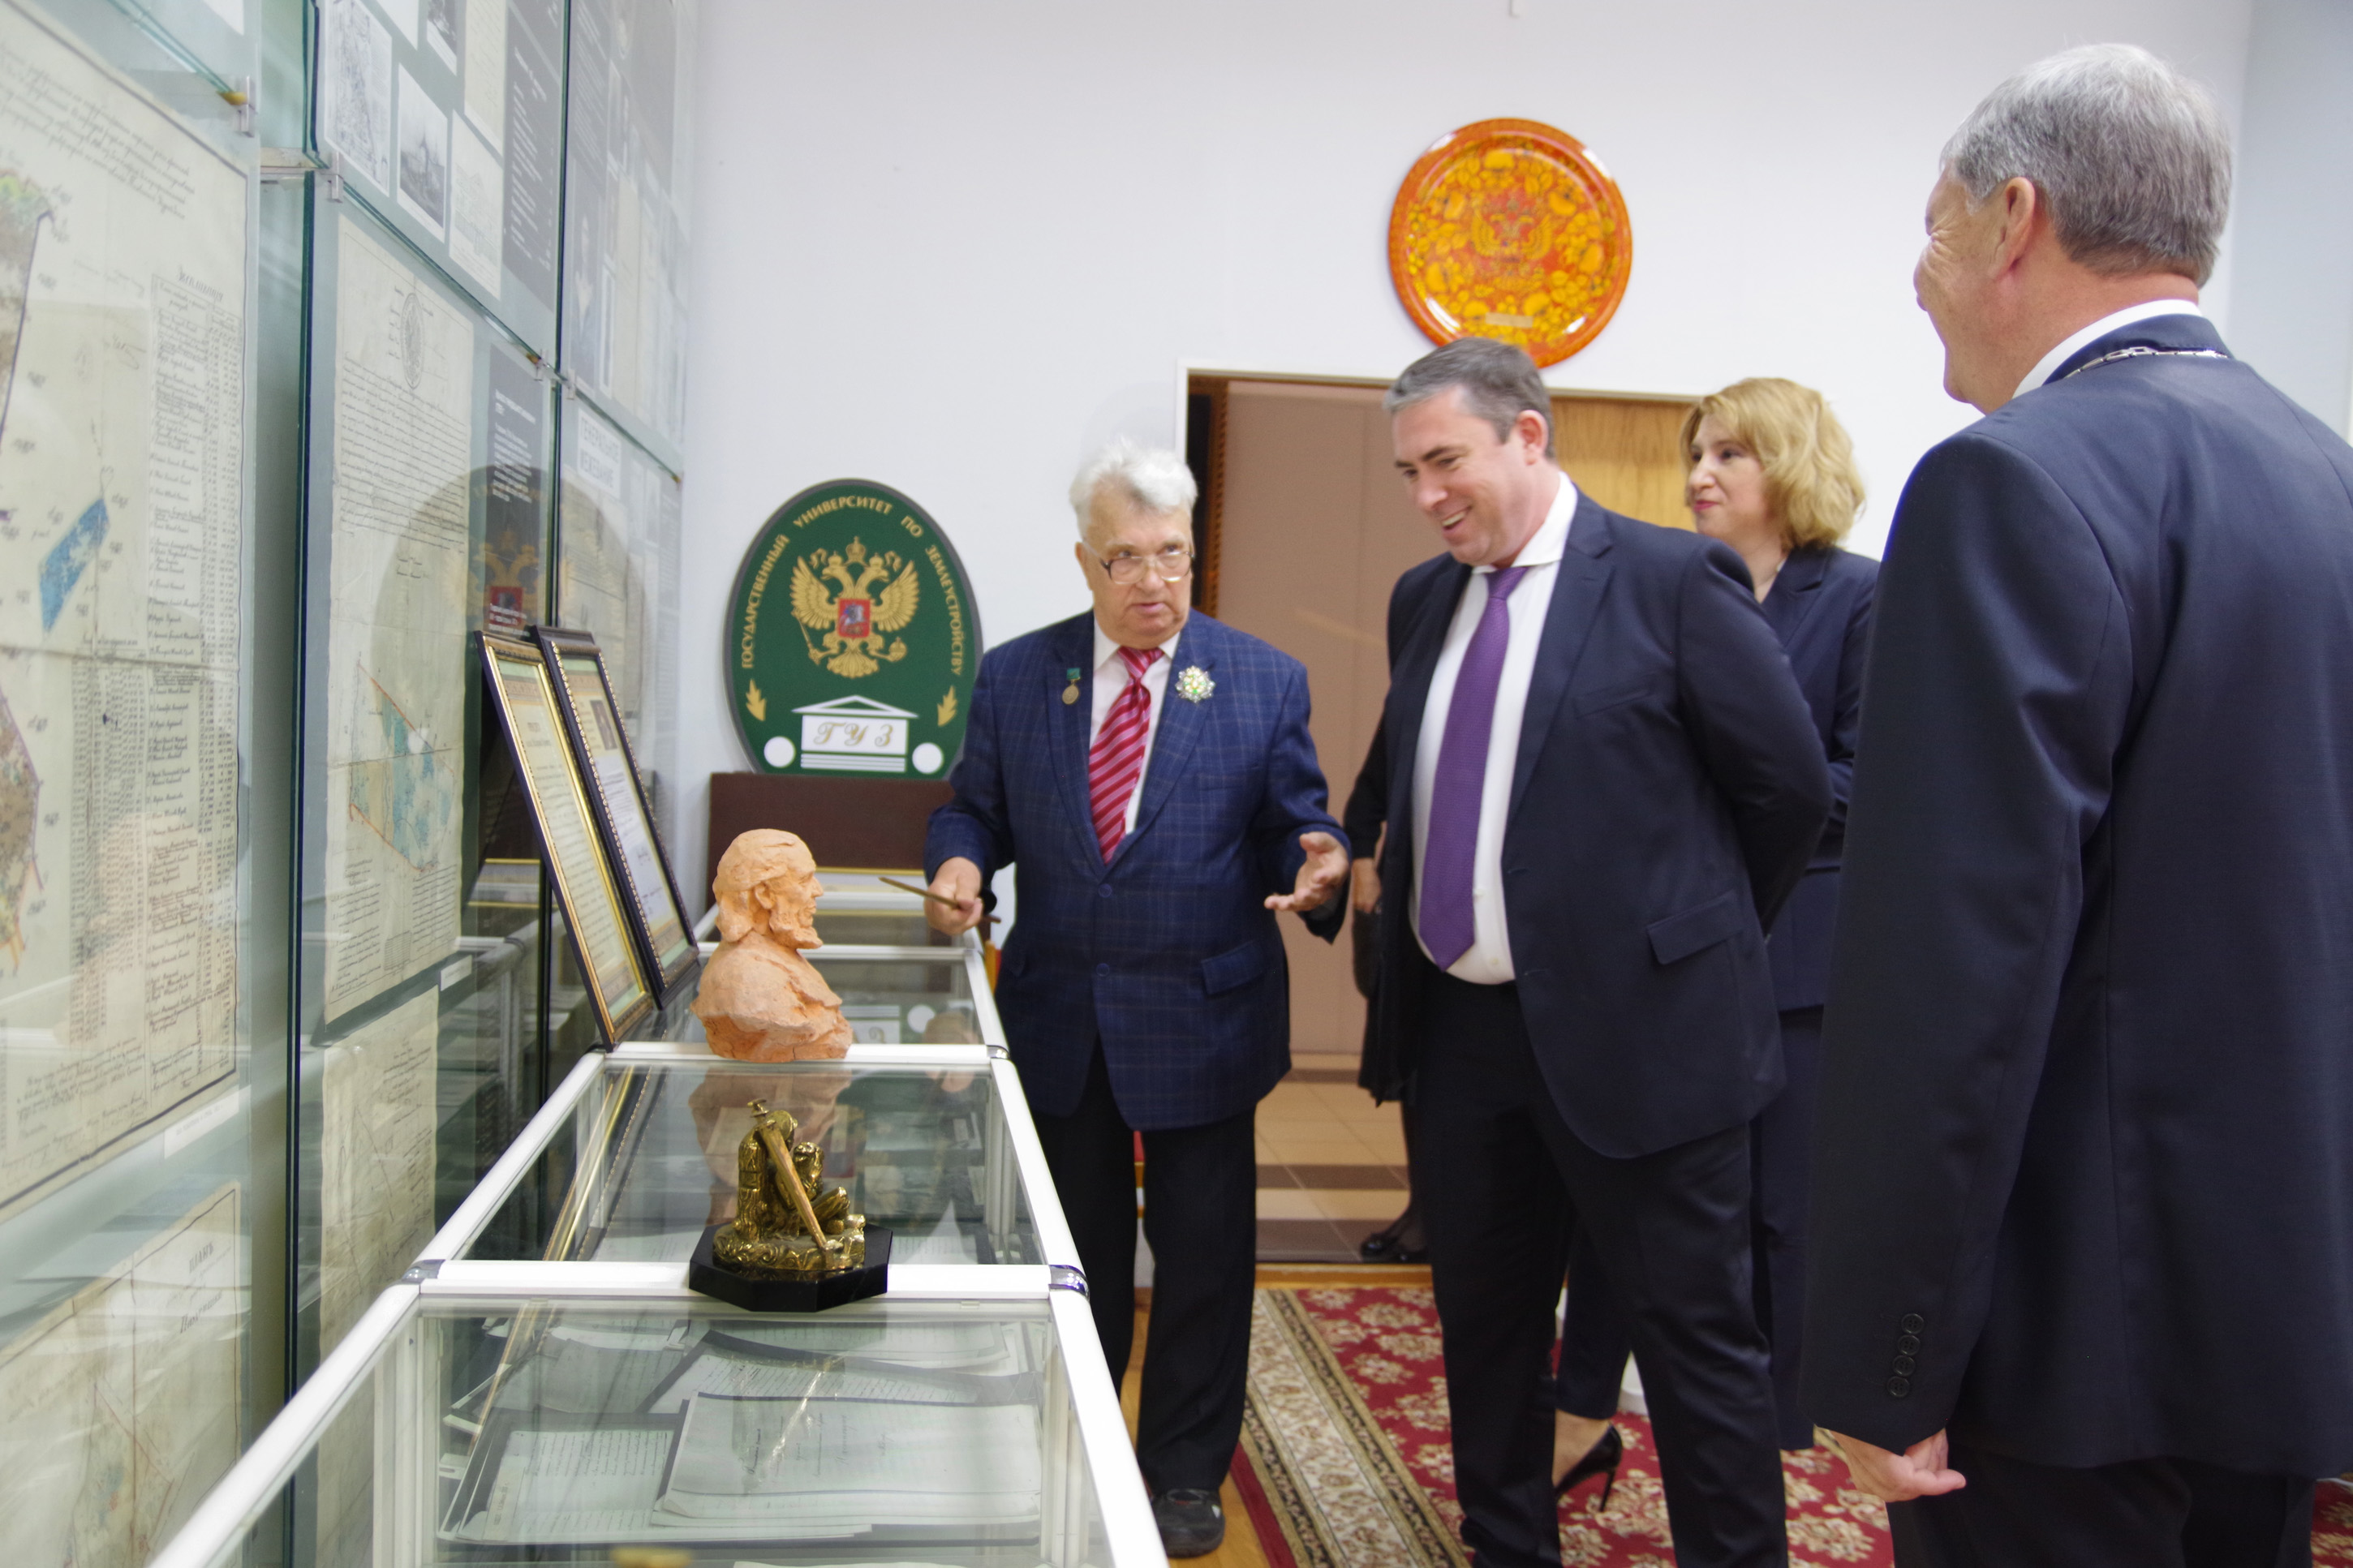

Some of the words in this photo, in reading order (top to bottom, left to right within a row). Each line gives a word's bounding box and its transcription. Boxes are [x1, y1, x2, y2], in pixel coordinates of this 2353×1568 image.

[741, 533, 790, 669] ГОСУДАРСТВЕННЫЙ
[792, 495, 893, 529] УНИВЕРСИТЕТ
[901, 515, 924, 538] ПО
[925, 544, 966, 676] ЗЕМЛЕУСТРОЙСТВУ
